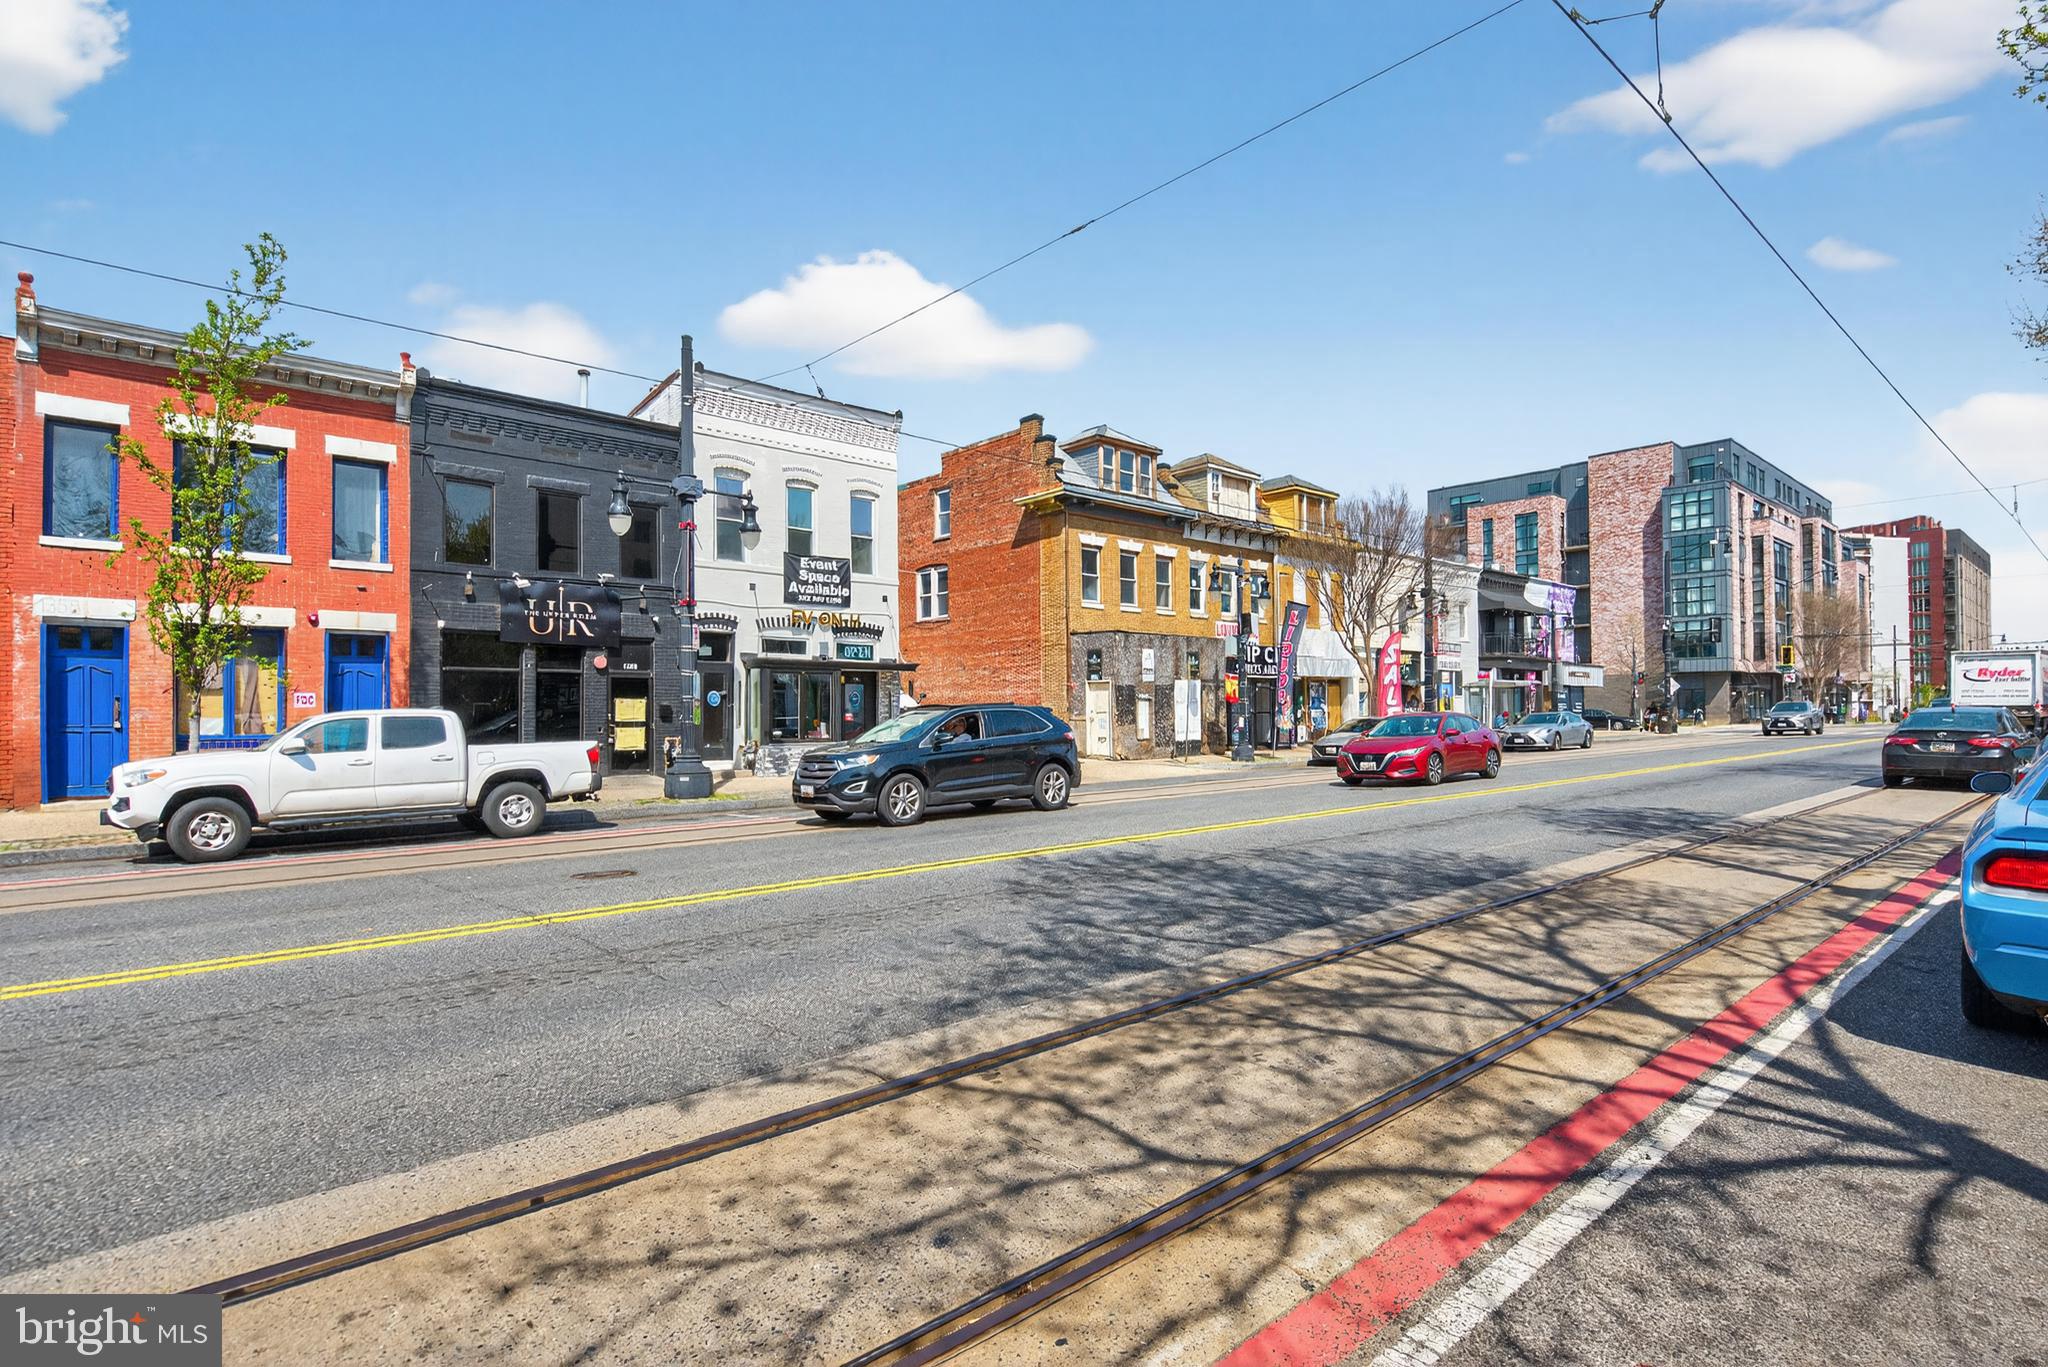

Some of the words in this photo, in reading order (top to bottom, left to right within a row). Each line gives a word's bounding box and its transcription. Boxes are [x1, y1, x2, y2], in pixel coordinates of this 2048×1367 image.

[800, 557, 838, 571] Event
[798, 569, 840, 583] Space
[788, 580, 850, 597] Available
[1977, 667, 2025, 678] Ryder
